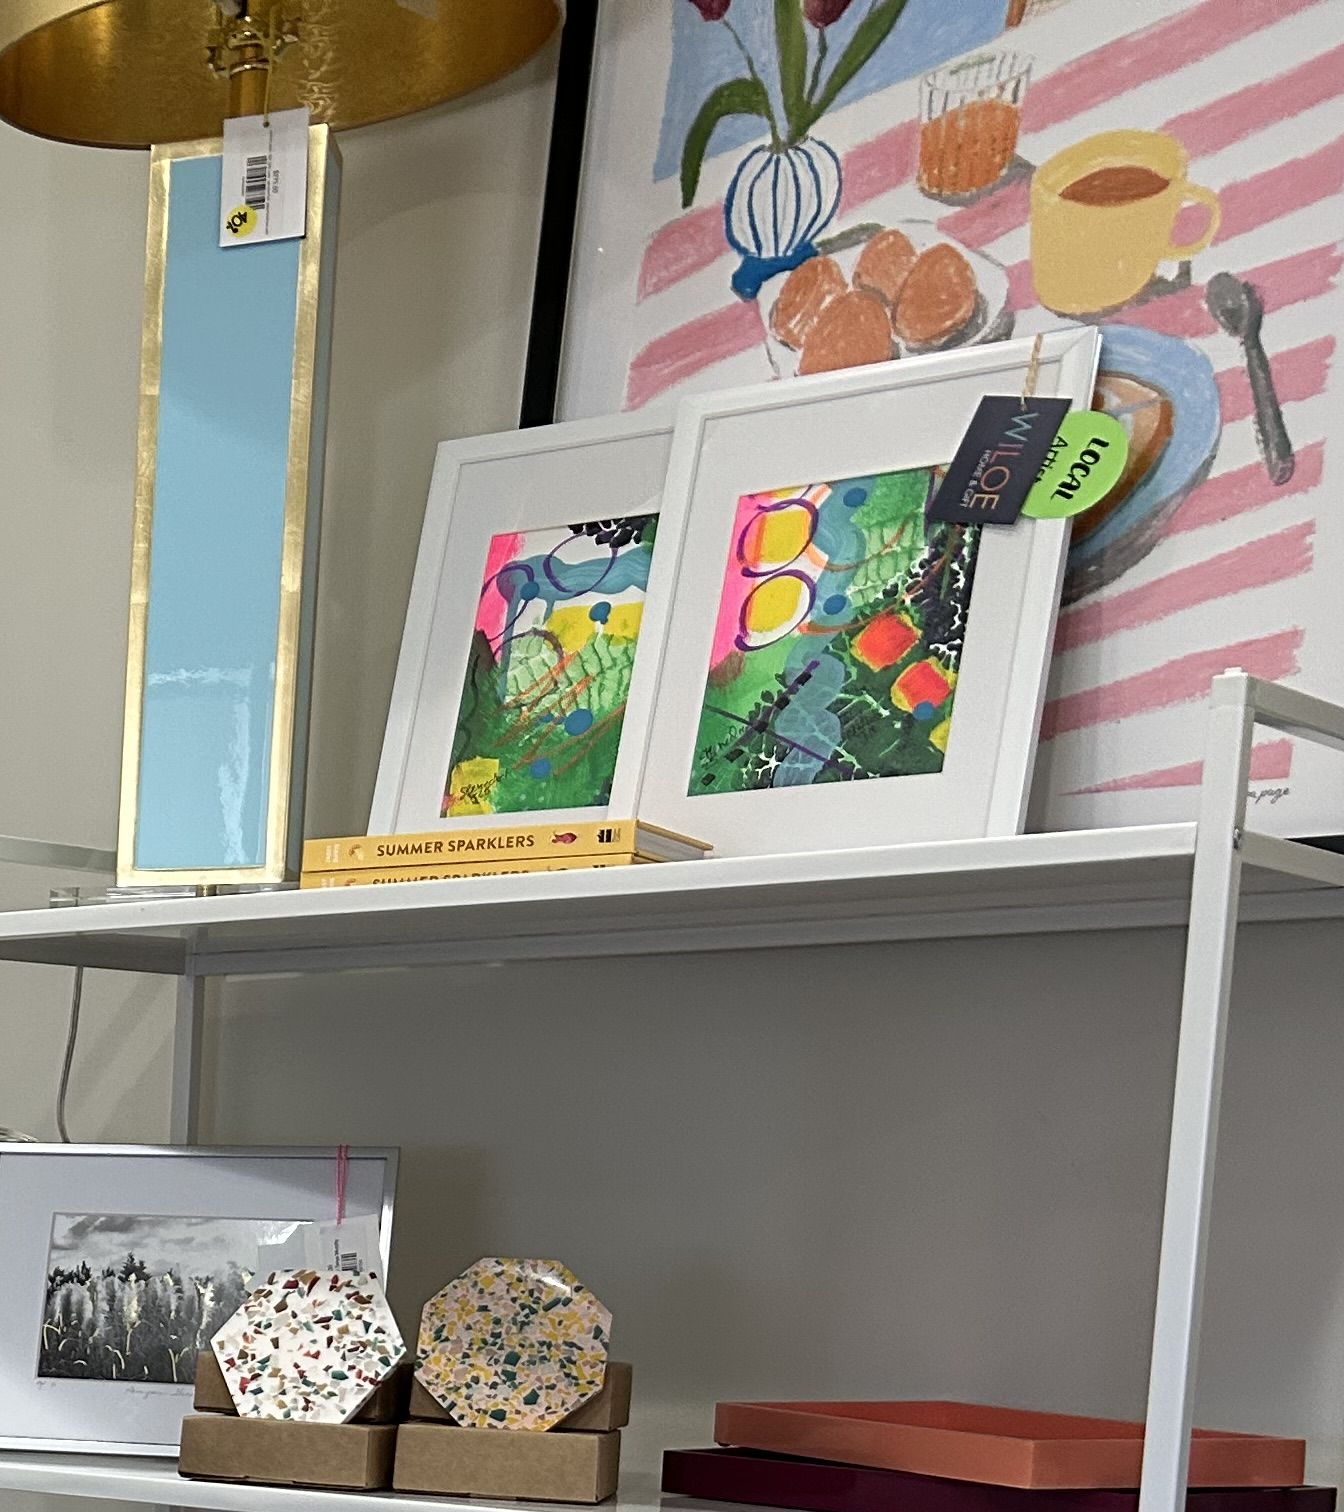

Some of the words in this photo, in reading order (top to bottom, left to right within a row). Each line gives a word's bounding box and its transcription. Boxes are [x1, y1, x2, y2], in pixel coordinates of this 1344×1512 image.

[969, 412, 1040, 511] WILOE
[1050, 437, 1109, 501] LOCAL
[376, 842, 444, 858] SUMMER
[448, 834, 535, 852] SPARKLERS
